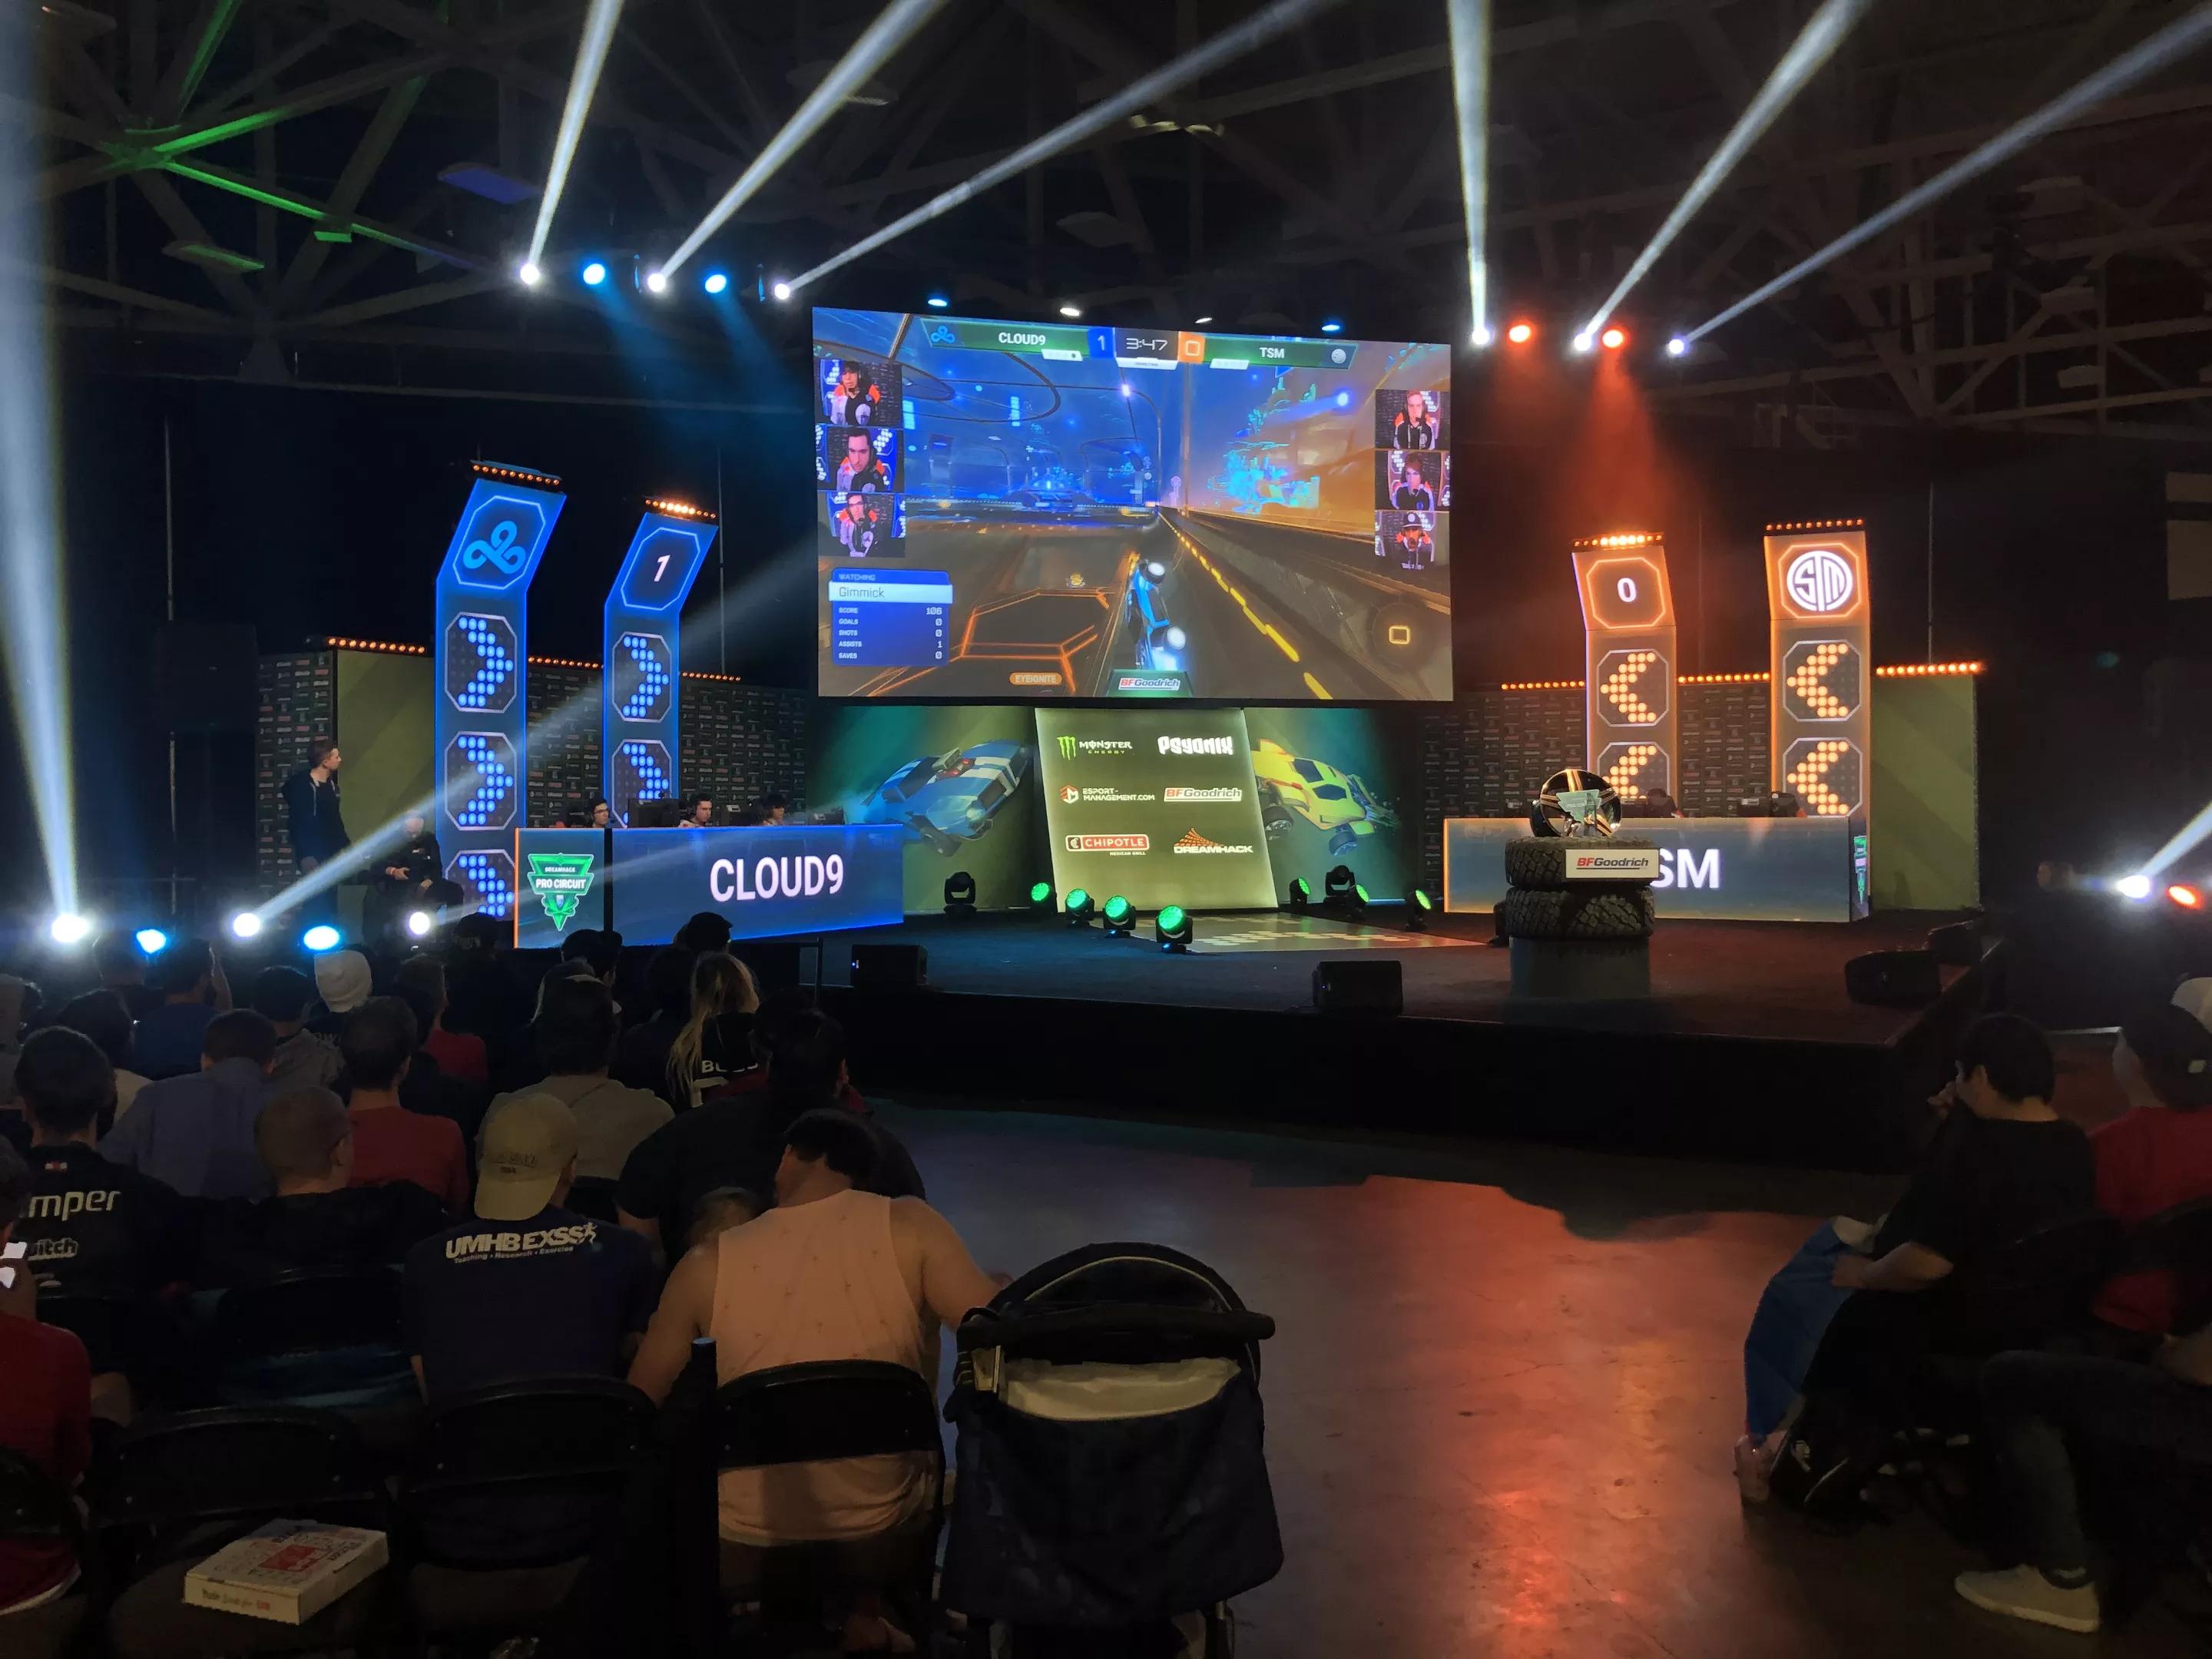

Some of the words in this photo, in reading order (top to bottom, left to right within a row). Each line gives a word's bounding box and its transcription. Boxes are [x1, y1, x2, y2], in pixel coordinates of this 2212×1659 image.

[998, 331, 1046, 346] CLOUD9
[1098, 335, 1106, 351] 1
[1125, 337, 1168, 352] 3:47
[1259, 346, 1285, 359] TSM
[654, 555, 671, 582] 1
[839, 587, 885, 598] Gimmick
[1617, 577, 1637, 603] 0
[935, 629, 942, 637] 0
[1015, 675, 1057, 684] EYEIGNITE
[1120, 678, 1180, 687] BFGoodrich
[1078, 740, 1133, 750] MONSTER
[1166, 788, 1241, 798] BFGoodrich
[1084, 838, 1145, 847] CHIPOTLE
[1173, 845, 1253, 854] DREAMHACK
[1577, 857, 1649, 866] BFGoodrich
[1650, 848, 1720, 889] SM
[535, 878, 552, 889] PRO
[554, 879, 586, 889] CIRCUIT
[710, 854, 843, 902] CLOUD9
[19, 1190, 121, 1221] mper
[445, 1232, 520, 1259] UMHB
[523, 1225, 585, 1251] EXSS
